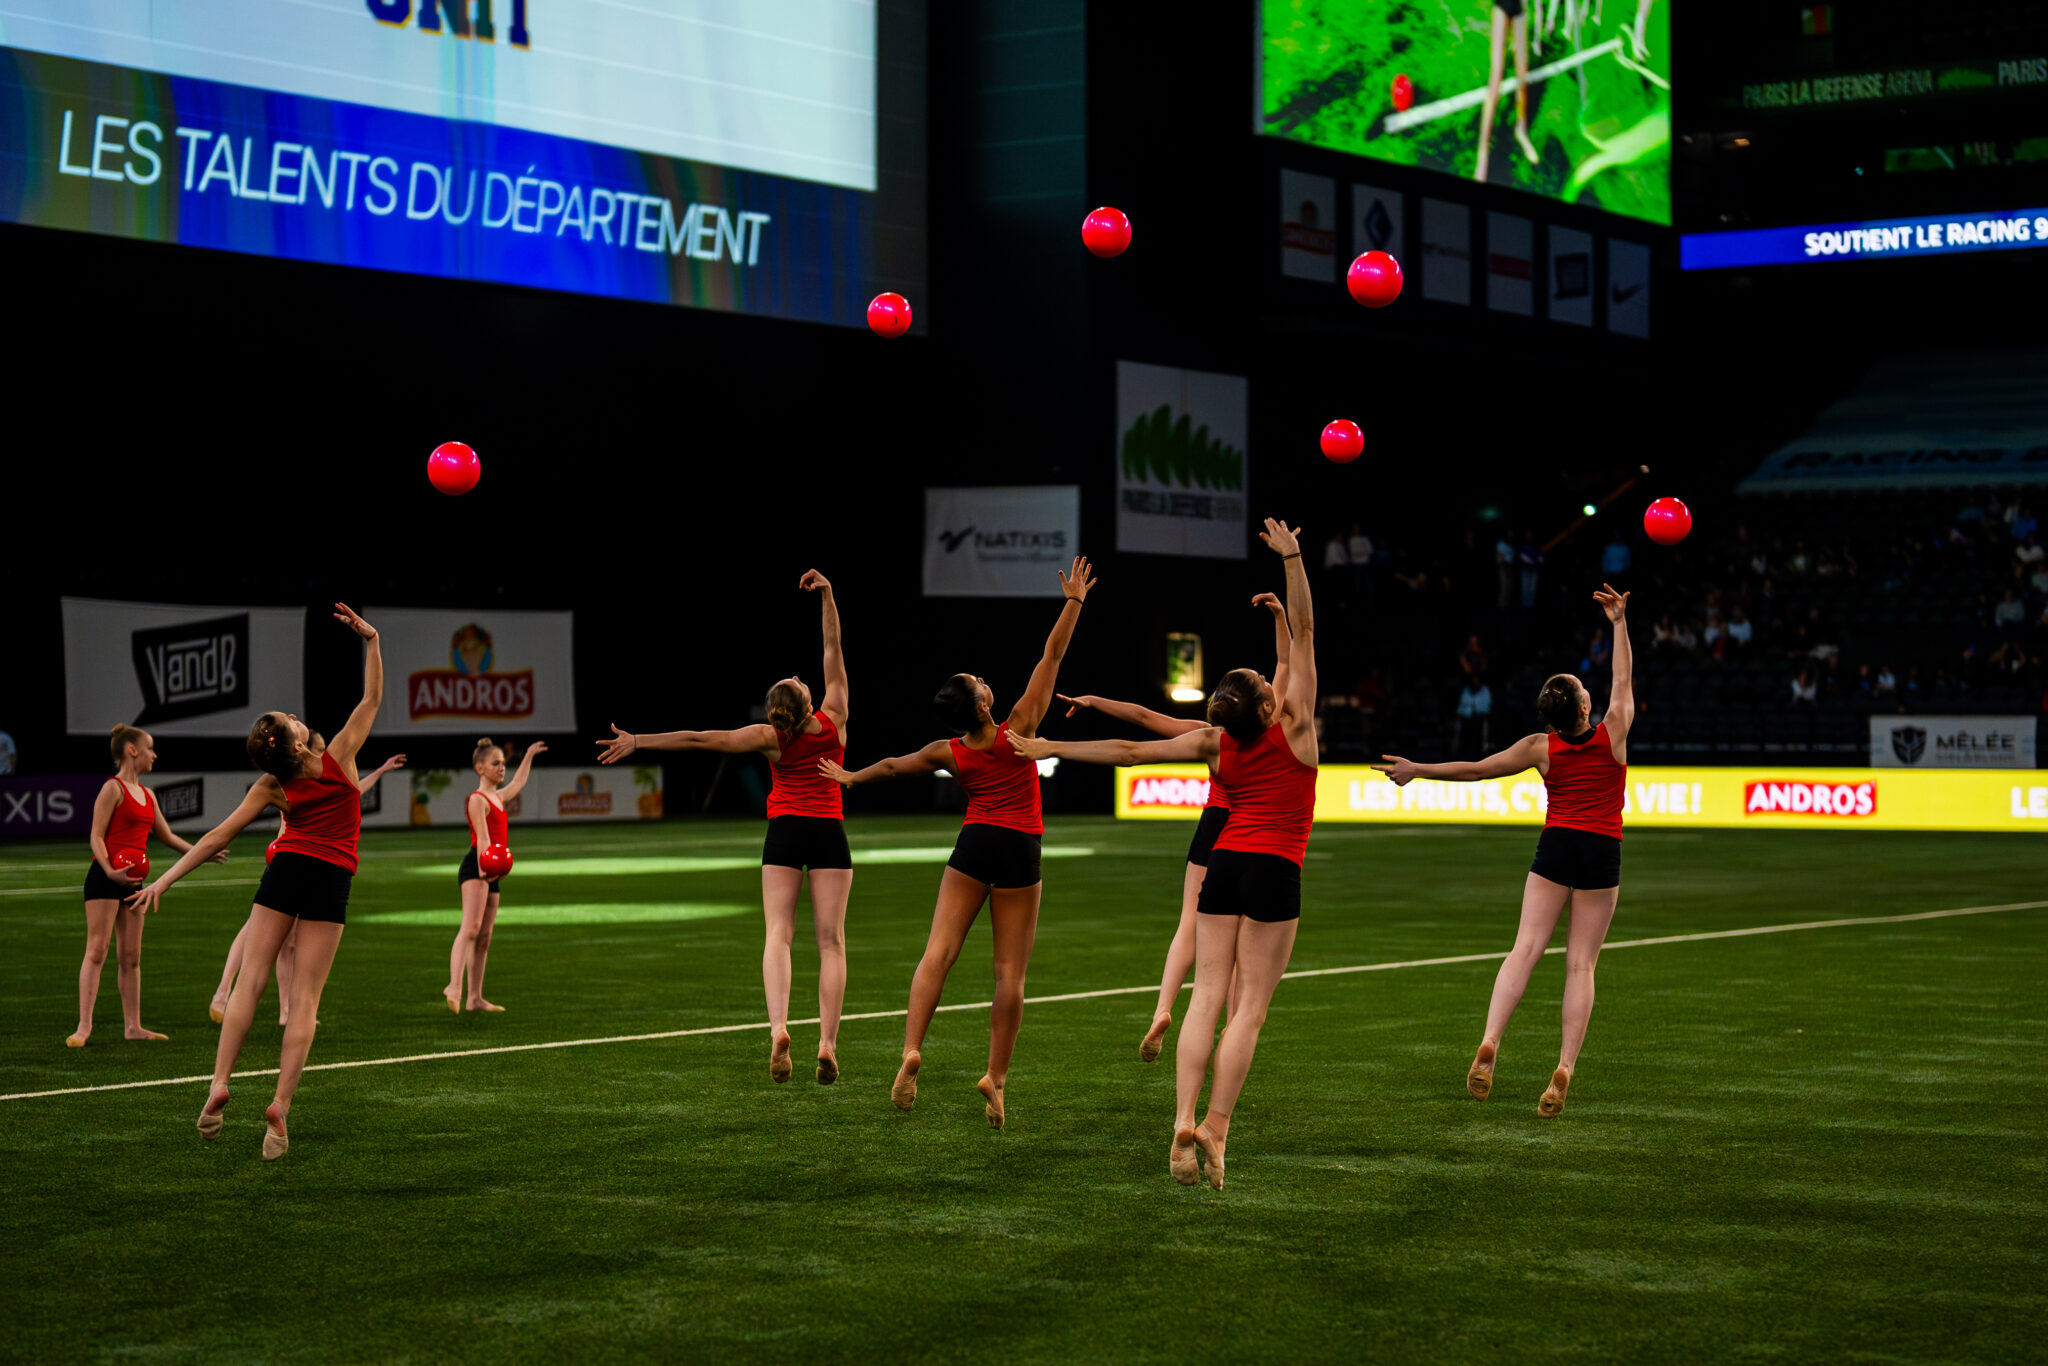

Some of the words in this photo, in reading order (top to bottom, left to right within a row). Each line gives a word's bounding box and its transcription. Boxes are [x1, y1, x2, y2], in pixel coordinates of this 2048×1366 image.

[1790, 79, 1813, 106] LA
[1812, 73, 1884, 103] DEFENSE
[1885, 68, 1933, 97] ARENA
[1998, 57, 2048, 87] PARIS
[58, 109, 164, 186] LES
[175, 125, 400, 217] TALENTS
[406, 161, 477, 226] DU
[481, 164, 771, 267] DÉPARTEMENT
[1803, 225, 1914, 257] SOUTIENT
[1915, 223, 1944, 249] LE
[1946, 217, 2031, 246] RACING
[413, 676, 531, 713] ANDROS
[1936, 728, 2016, 750] MÊLÉE
[3, 789, 74, 824] XIS
[1349, 780, 1399, 811] LES
[1401, 780, 1508, 816] FRUITS,
[1747, 781, 1874, 816] ANDROS
[2011, 786, 2048, 818] LE
